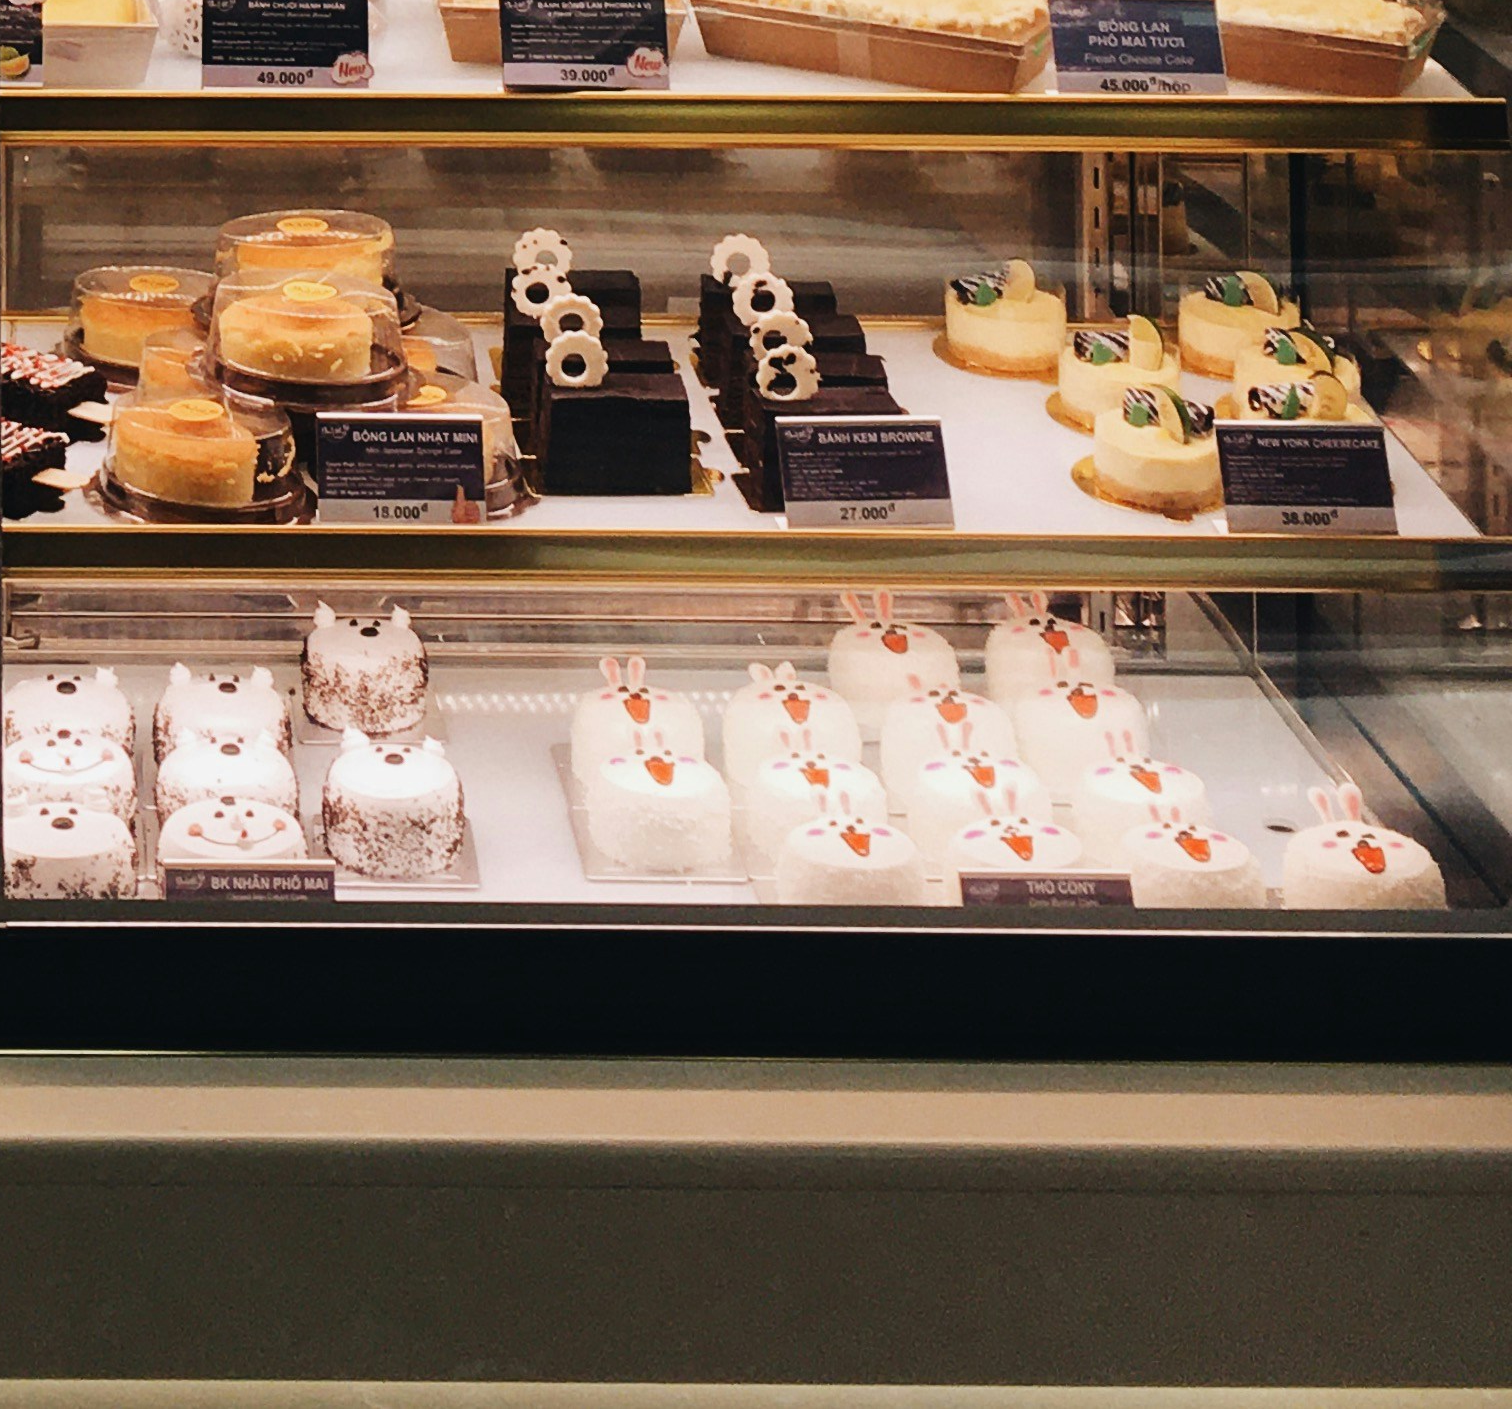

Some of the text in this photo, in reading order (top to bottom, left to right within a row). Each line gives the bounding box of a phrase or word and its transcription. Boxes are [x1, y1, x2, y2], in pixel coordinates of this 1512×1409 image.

[1098, 18, 1170, 33] BÔNG LAN
[1088, 33, 1118, 47] PHÔ
[1121, 36, 1147, 47] MAI
[635, 56, 662, 71] New
[1118, 53, 1162, 65] Cheese
[1164, 53, 1195, 65] Cake
[338, 62, 366, 77] New
[352, 429, 387, 442] BÔNG
[390, 432, 415, 442] LAN
[452, 432, 478, 443] MINI
[818, 431, 934, 444] BÁNH KEM BROWNIE
[1257, 438, 1381, 449] NEW YORK CHEESECAKE
[211, 877, 230, 889] BK
[304, 877, 329, 890] MAI
[1057, 881, 1096, 894] CONY
